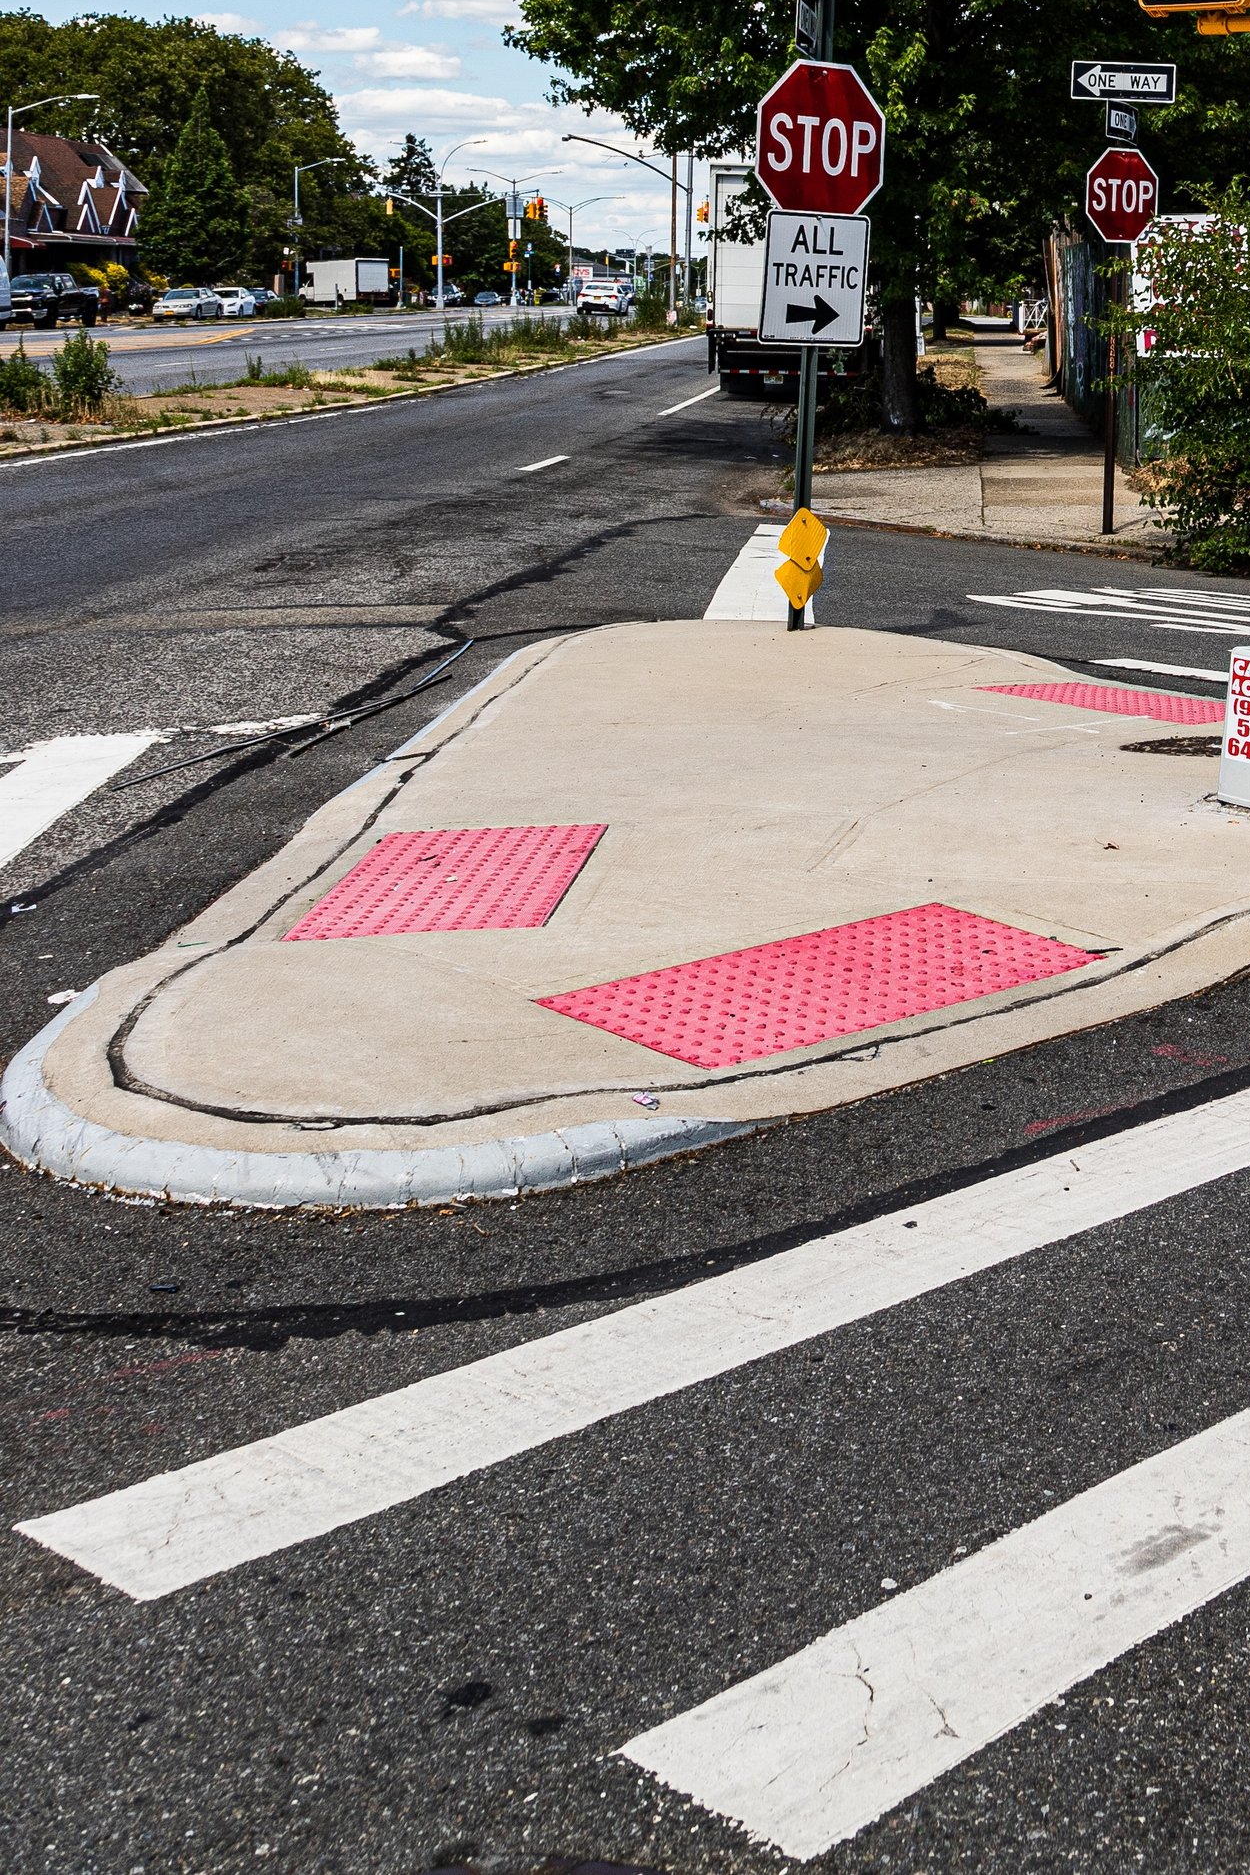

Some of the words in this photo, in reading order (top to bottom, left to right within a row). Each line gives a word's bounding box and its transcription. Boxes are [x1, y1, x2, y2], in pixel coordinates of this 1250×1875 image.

[1088, 73, 1116, 88] ONE
[1130, 75, 1161, 90] WAY
[767, 112, 877, 178] STOP
[1092, 177, 1154, 213] STOP
[790, 224, 843, 256] ALL
[772, 262, 859, 290] TRAFFIC
